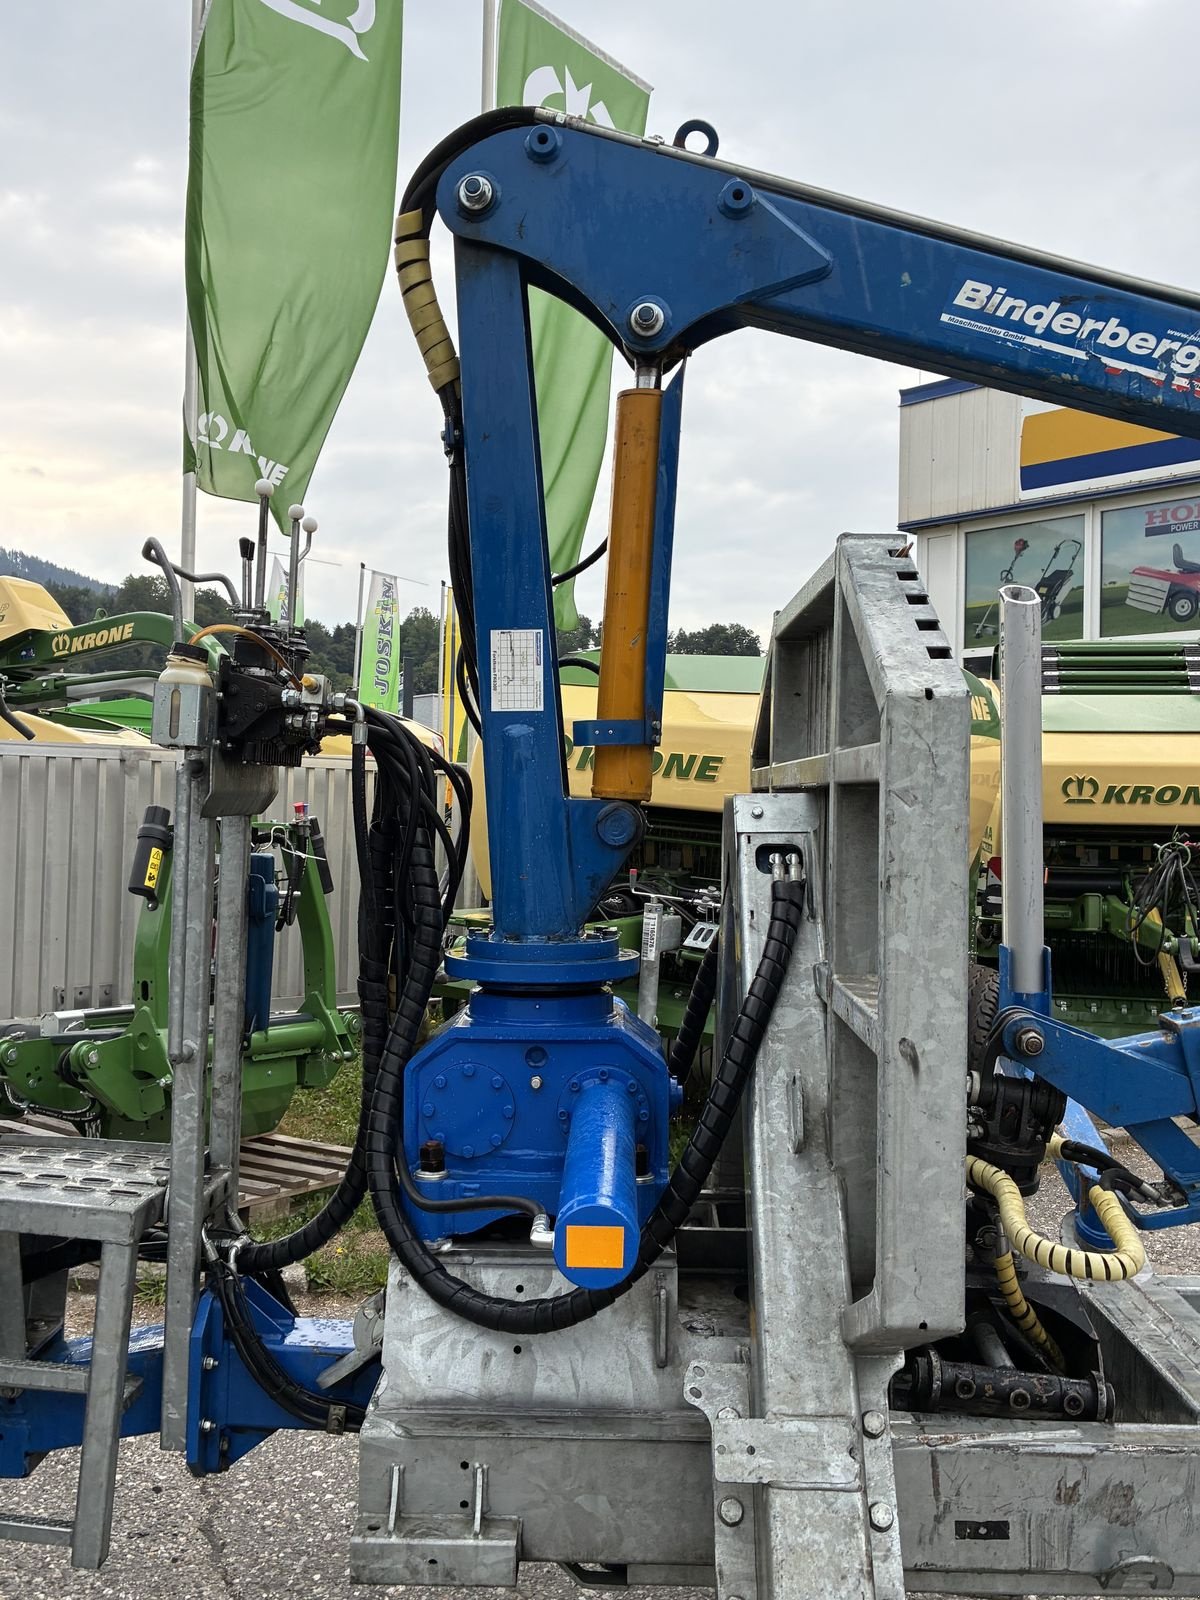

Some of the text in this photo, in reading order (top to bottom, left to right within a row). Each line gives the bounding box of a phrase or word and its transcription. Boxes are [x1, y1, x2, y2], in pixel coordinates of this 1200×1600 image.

[947, 316, 1027, 342] Maschinenbau GmbH
[1170, 521, 1199, 532] POWER
[71, 622, 135, 652] KRONE
[374, 577, 395, 696] JOSKIN
